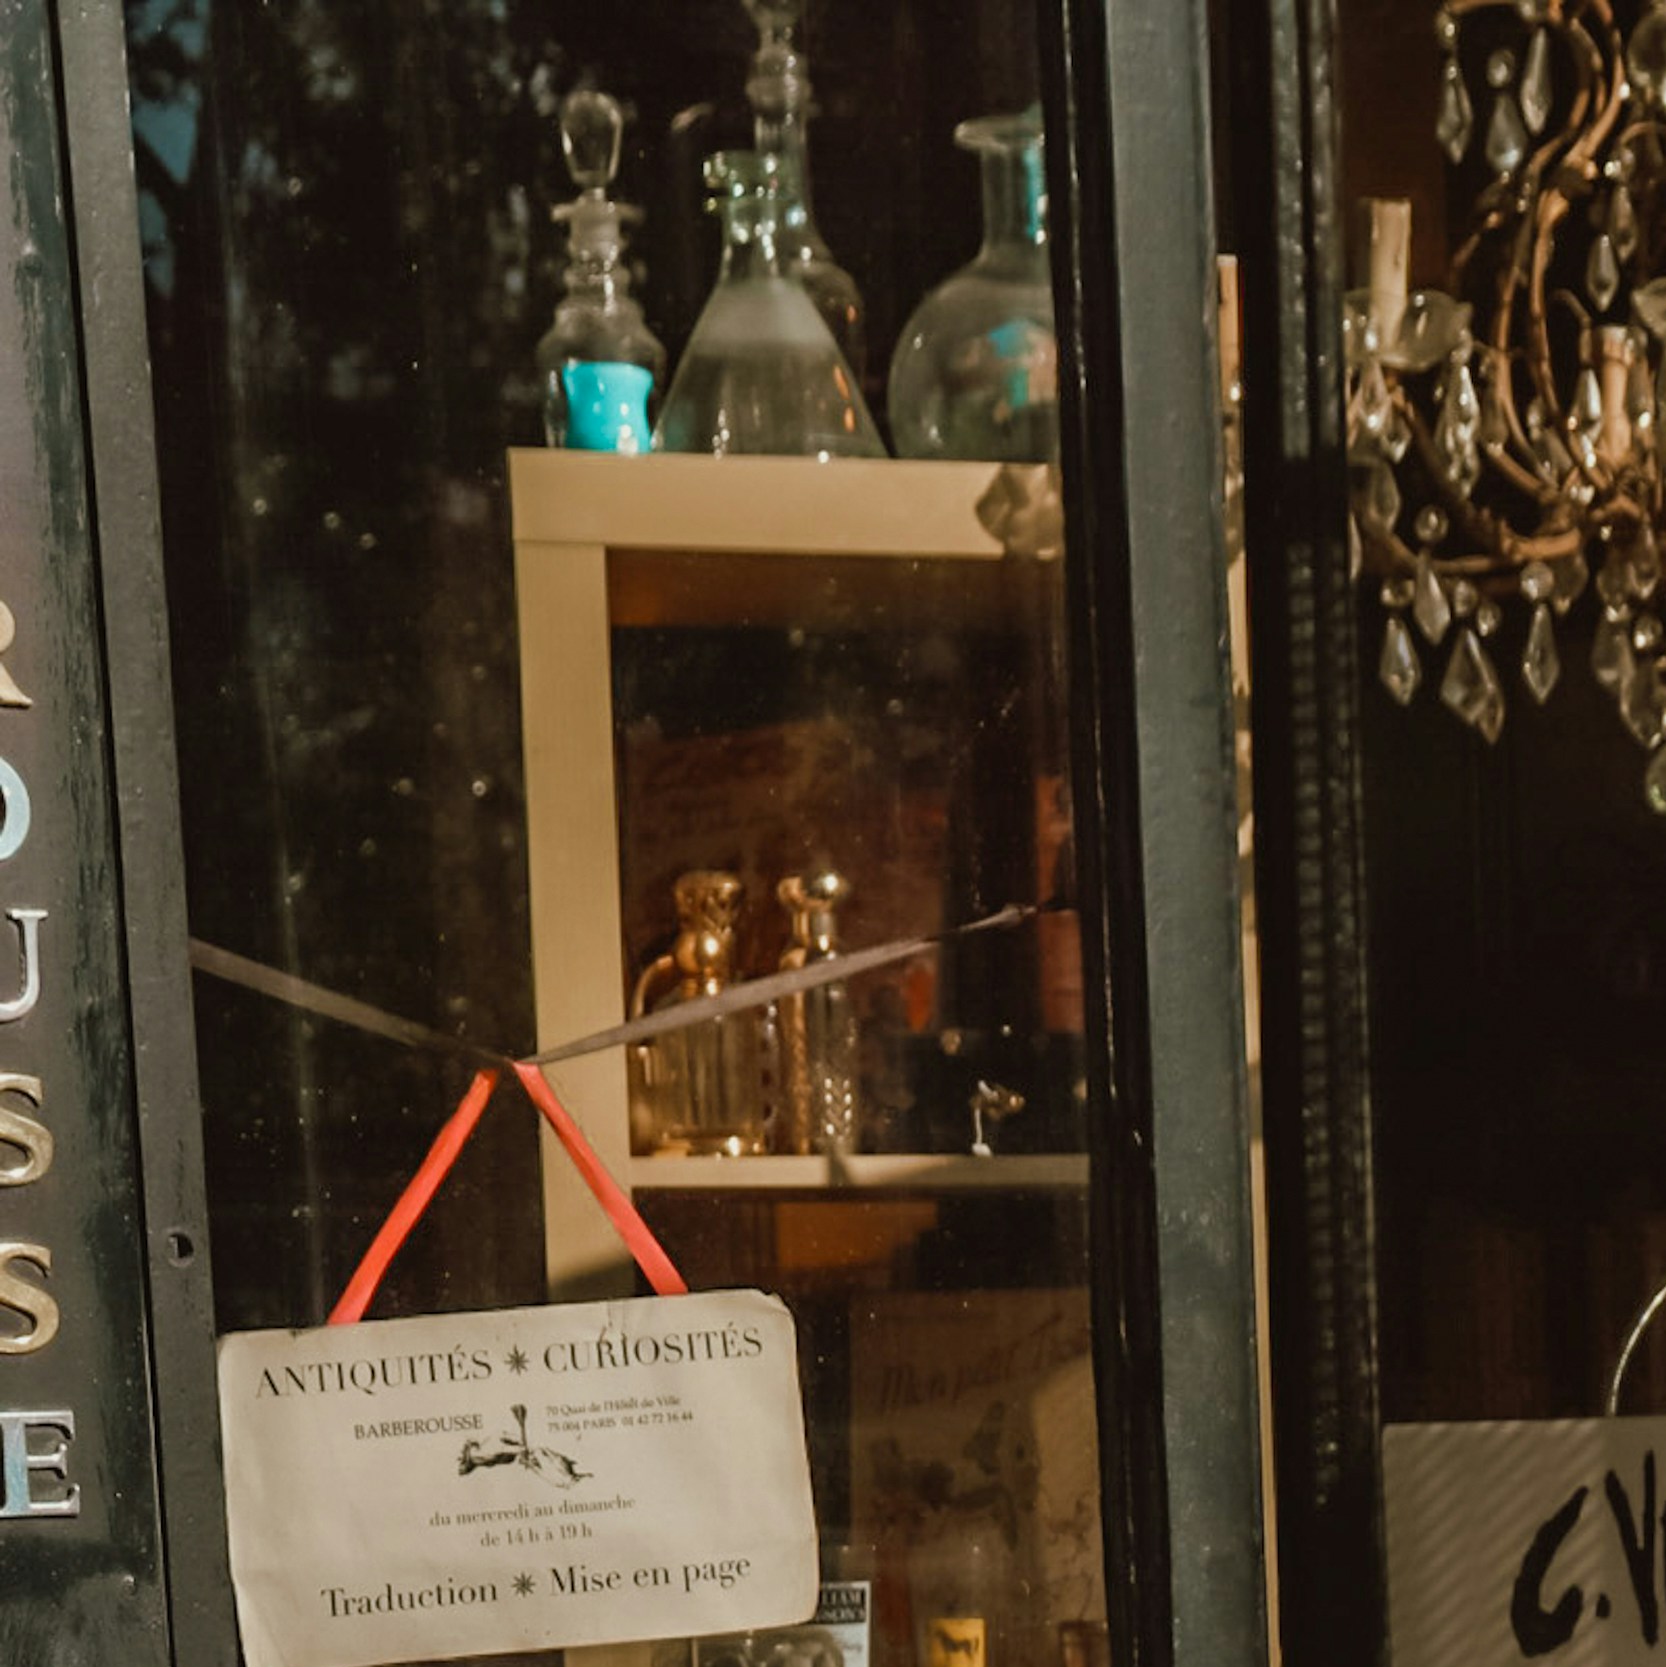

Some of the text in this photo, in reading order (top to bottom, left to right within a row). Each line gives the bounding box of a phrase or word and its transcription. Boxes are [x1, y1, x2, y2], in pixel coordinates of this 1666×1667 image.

[256, 1322, 765, 1398] ANTIQUITÉS CURIOSITÉS
[354, 1414, 484, 1440] BARBEROUSSE
[582, 1417, 617, 1431] PARIS
[430, 1494, 636, 1528] du mercredi au dimanche
[480, 1521, 593, 1548] de 14 h à 19 h
[320, 1554, 752, 1619] Traduction Mise en page
